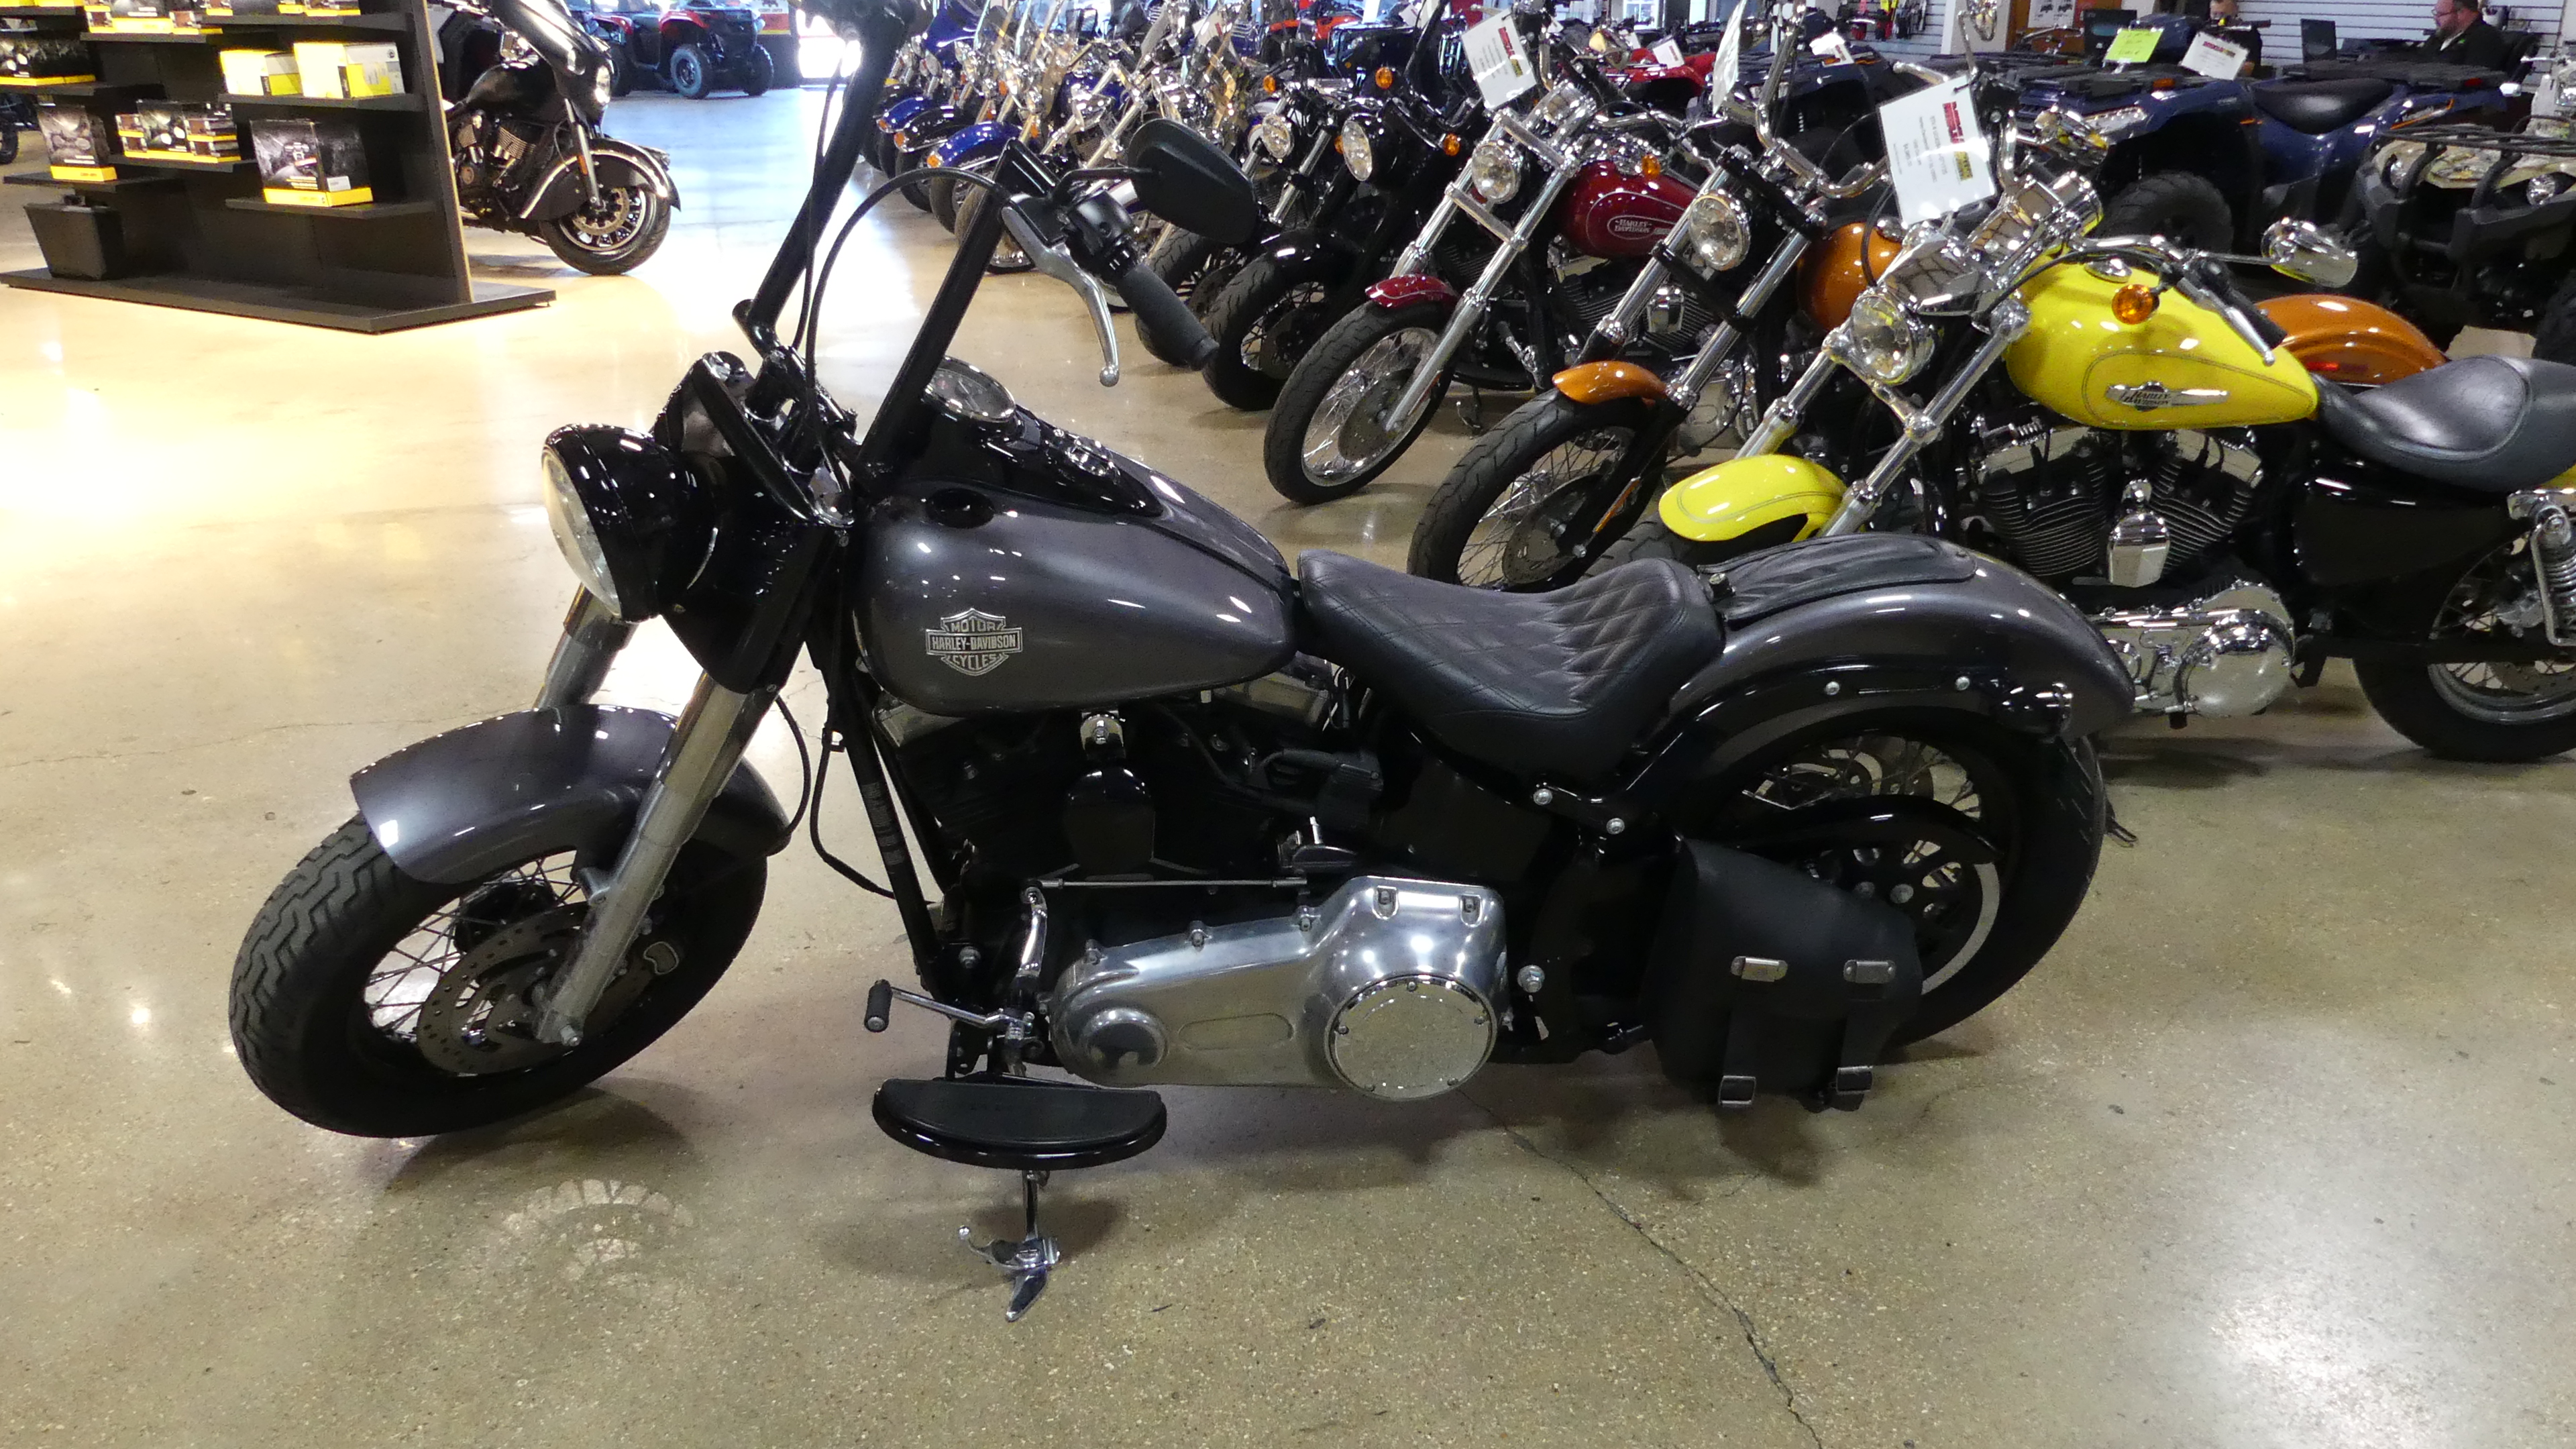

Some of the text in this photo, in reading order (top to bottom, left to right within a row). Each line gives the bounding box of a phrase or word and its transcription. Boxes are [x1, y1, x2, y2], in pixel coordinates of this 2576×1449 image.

[951, 616, 996, 632] MOTOR
[932, 635, 1016, 651] HARLEY-DAVIDSON
[953, 653, 997, 670] CYCLES
